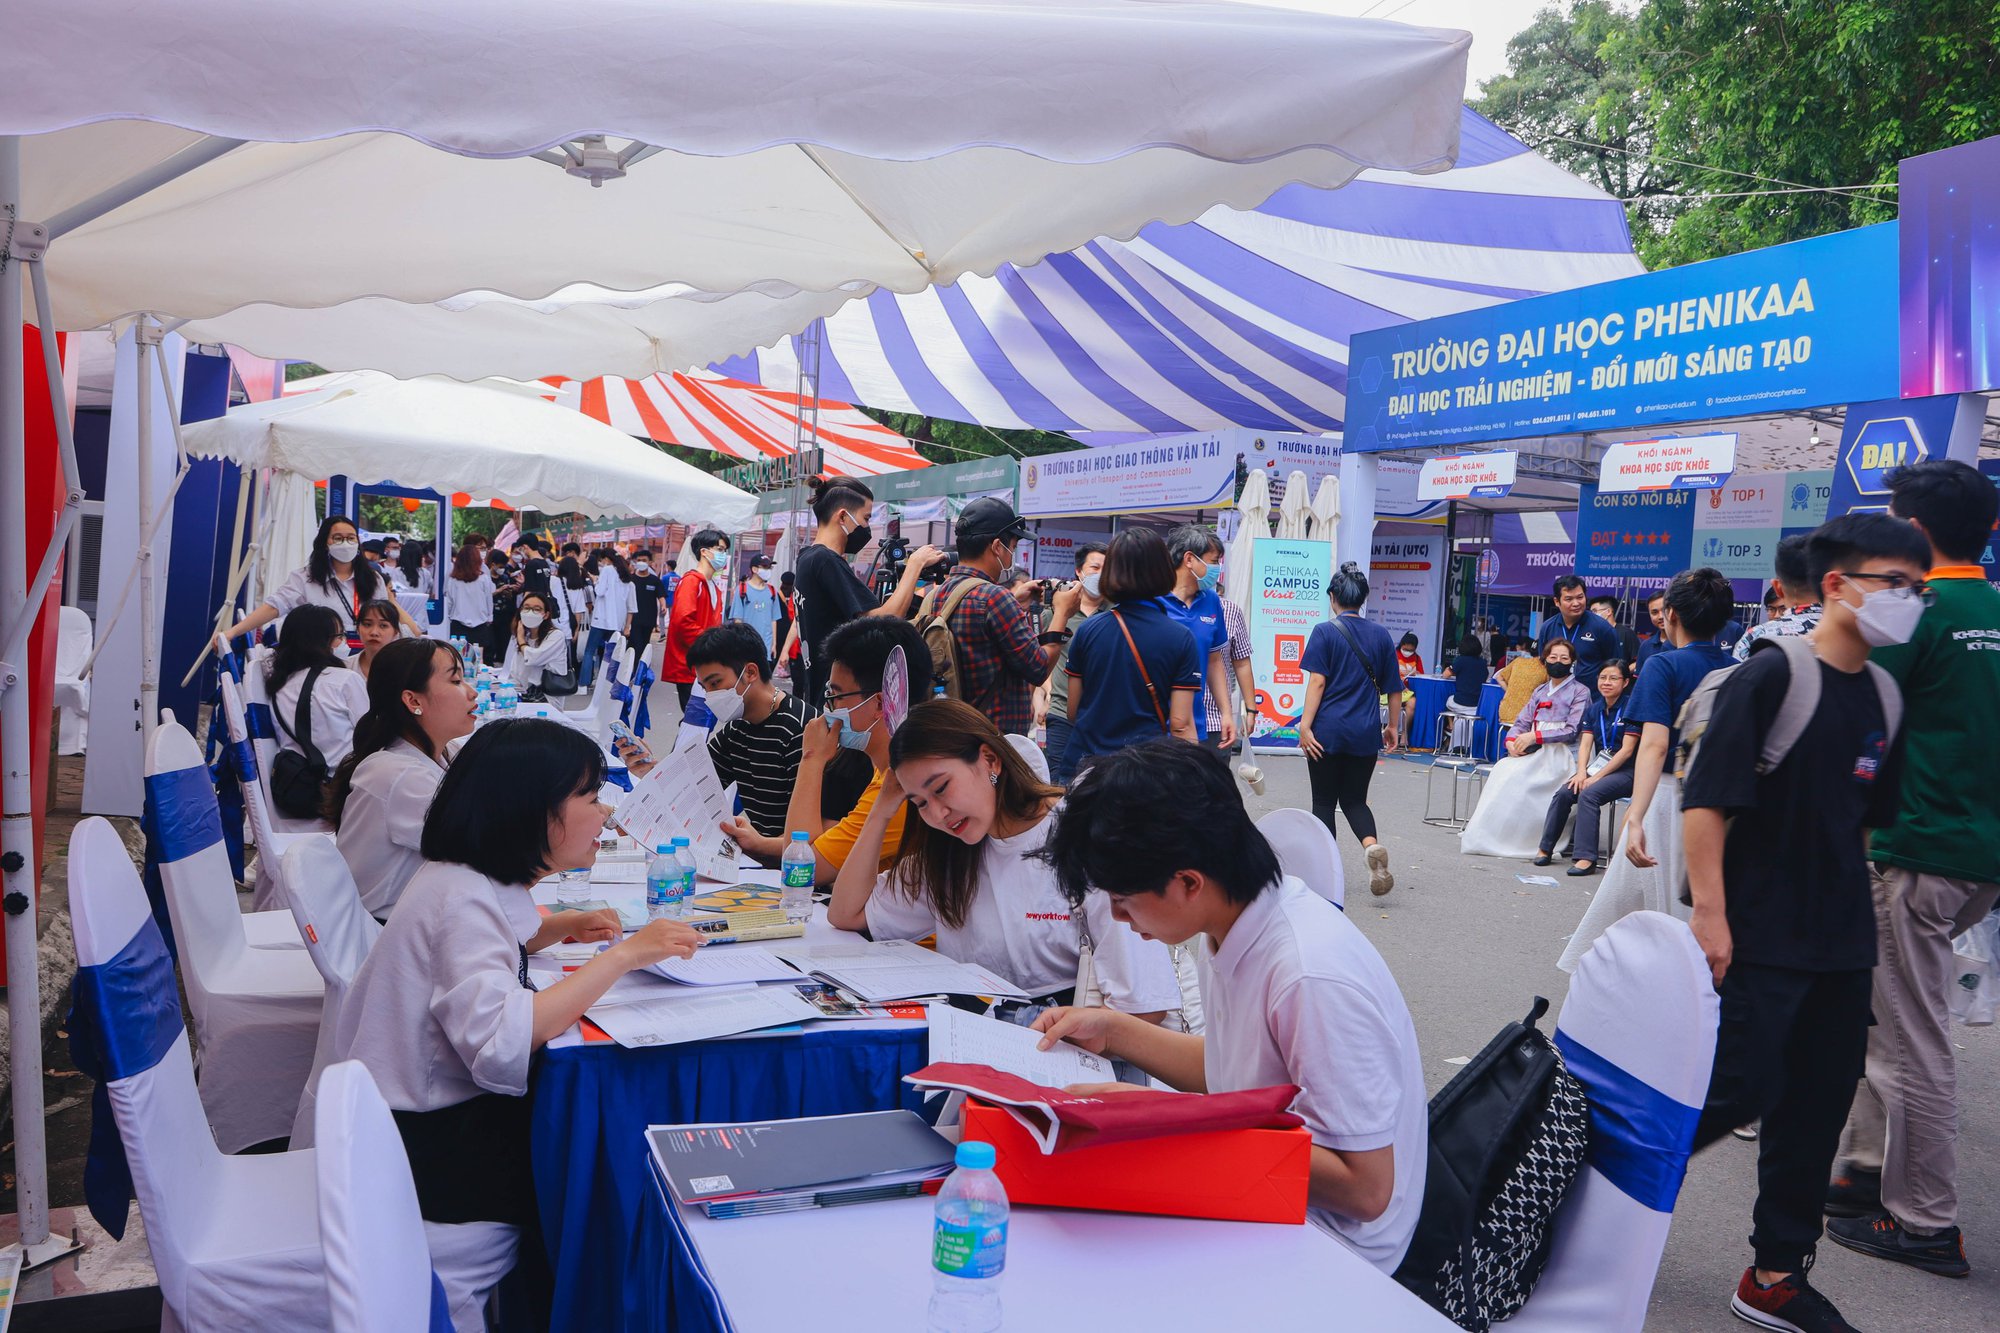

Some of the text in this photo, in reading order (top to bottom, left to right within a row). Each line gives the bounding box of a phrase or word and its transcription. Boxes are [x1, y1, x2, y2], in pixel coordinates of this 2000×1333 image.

[1392, 277, 1815, 380] TRƯỜNG ĐẠI HỌC PHENIKAA
[1388, 395, 1414, 420] ĐẠI
[1418, 388, 1451, 417] HỌC
[1455, 376, 1493, 409] TRẢI
[1497, 369, 1572, 404] NGHIỆM
[1591, 354, 1628, 391] ĐỔI
[1633, 351, 1678, 385] MỚI
[1684, 344, 1753, 379] SÁNG
[1760, 335, 1812, 372] TẠO
[1643, 400, 1697, 413] phenikaa-uni.edu.vn
[1277, 440, 1313, 455] TRƯỜNG
[1314, 443, 1330, 458] ĐẠI
[1637, 446, 1693, 459] KHỐI NGÀNH
[1043, 435, 1221, 477] TRƯỜNG ĐẠI HỌC GIAO THÔNG VẬN TẢI
[1282, 456, 1316, 466] University
[1318, 458, 1325, 466] of
[1445, 461, 1485, 471] KHỐI NGÀNH
[1620, 457, 1710, 475] KHOA HỌC SỨC KHỎE
[1126, 470, 1137, 481] and
[1140, 467, 1192, 480] Communications
[1432, 471, 1498, 486] KHOA HỌC SỨC KHỎE
[1682, 475, 1709, 483] PHENIKAA
[1593, 495, 1619, 507] CON
[1732, 488, 1764, 502] TOP 1
[1039, 536, 1073, 548] 24.000
[1591, 531, 1619, 550] ĐẠT
[1384, 542, 1400, 556] TẢI
[1402, 544, 1429, 558] (UTC)
[1727, 544, 1762, 557] TOP 3
[1526, 550, 1576, 567] TRƯỜNG
[1264, 565, 1320, 577] PHENIKAA
[1264, 576, 1320, 590] CAMPUS
[1263, 589, 1320, 601] Visit 2022
[1262, 607, 1320, 618] TRƯỜNG ĐẠI HỌC
[1273, 617, 1308, 625] PHENIKAA
[1952, 629, 1986, 640] KHOA
